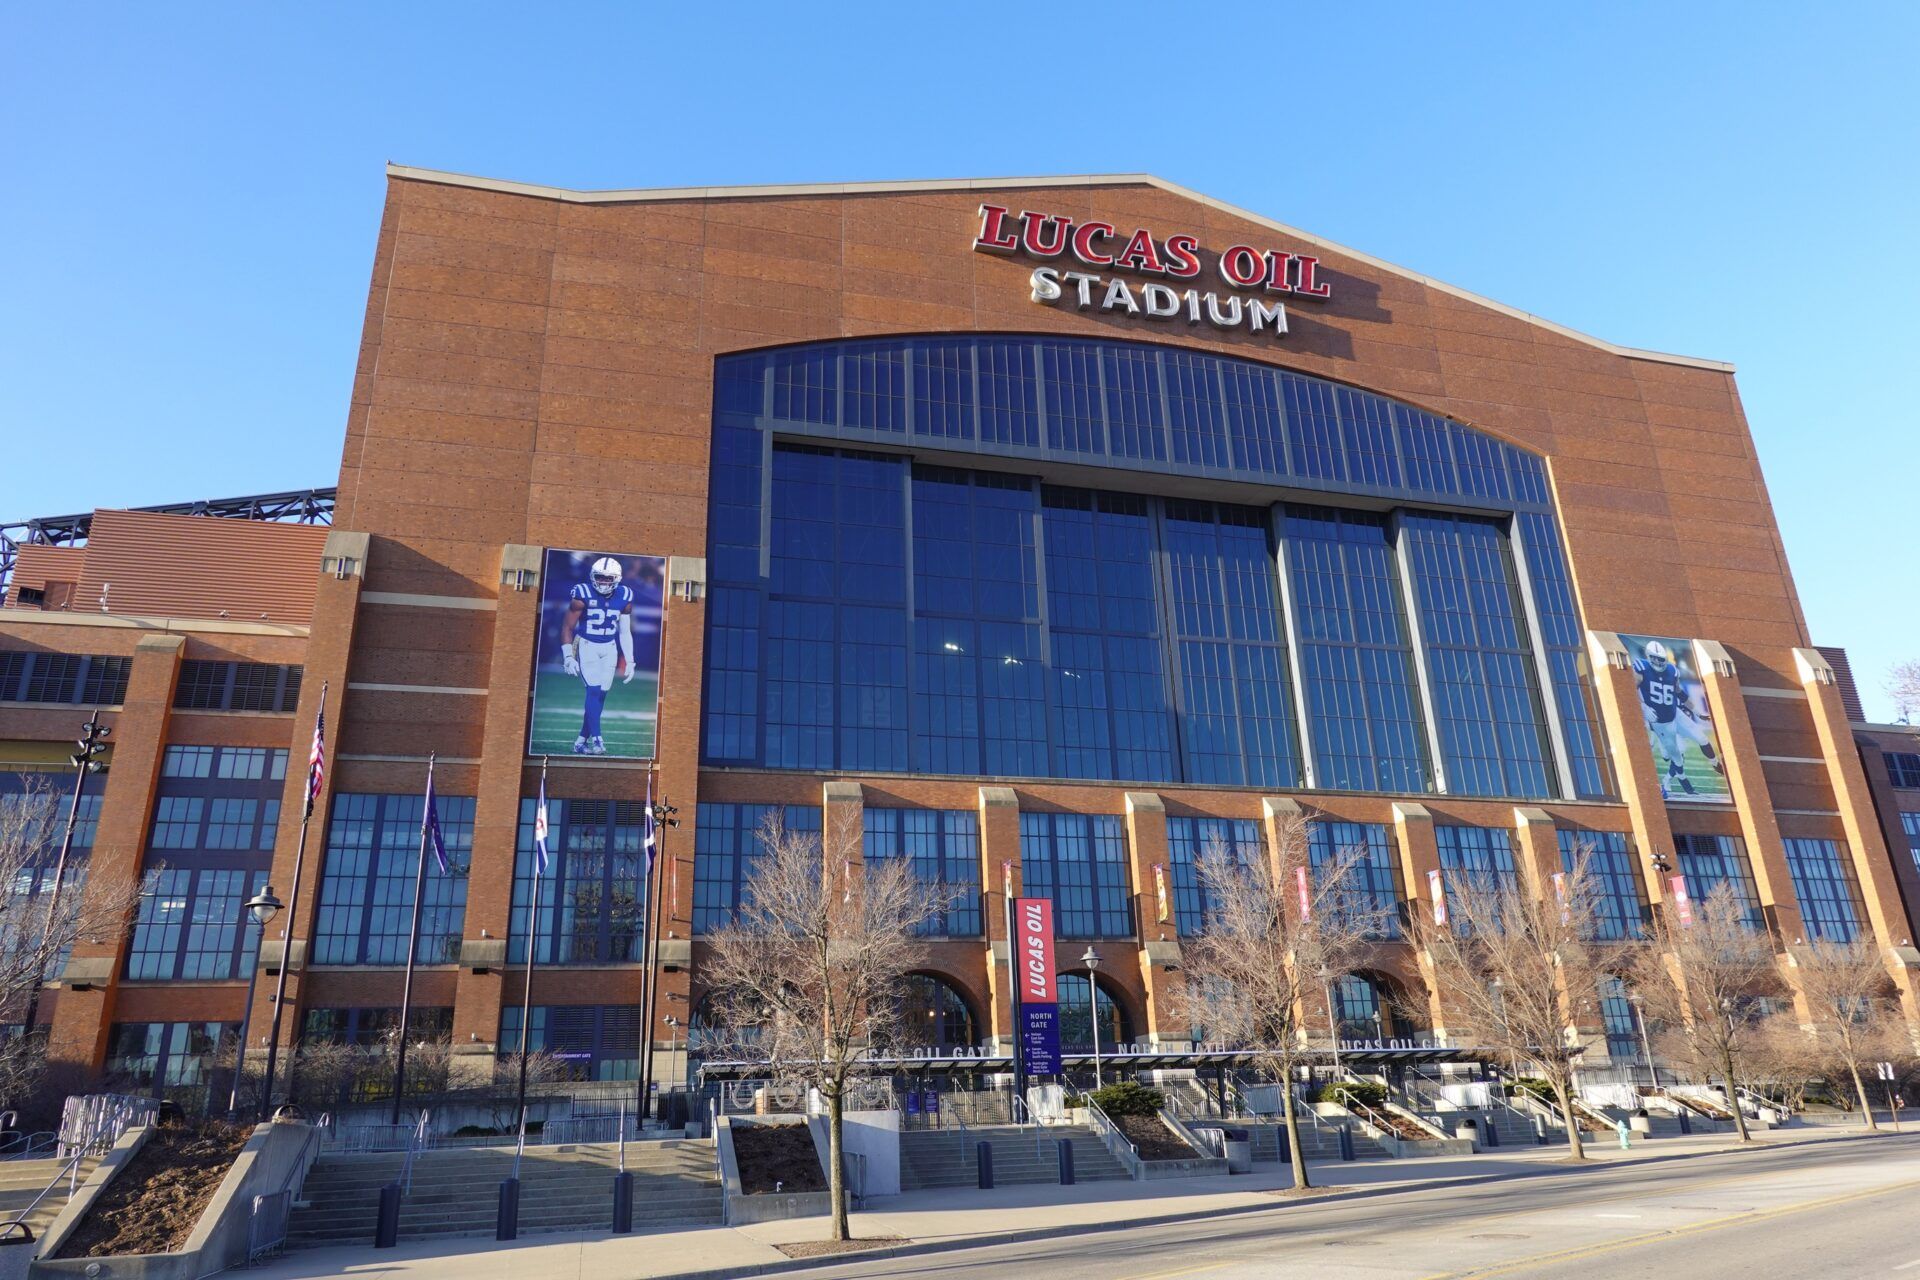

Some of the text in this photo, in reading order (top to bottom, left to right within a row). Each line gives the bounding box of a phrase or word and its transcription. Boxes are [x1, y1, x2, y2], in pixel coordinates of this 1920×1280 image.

[973, 203, 1331, 302] LUCAS OIL
[1029, 266, 1289, 338] STADIUM
[586, 608, 620, 635] 23
[1650, 681, 1675, 706] 56
[1026, 904, 1047, 998] LUCAS OIL
[1030, 1012, 1052, 1020] NORTH
[1030, 1021, 1048, 1029] GATE
[913, 1047, 940, 1058] OIL
[952, 1046, 997, 1058] GATE
[1341, 1038, 1458, 1050] UCAS OIL GAE
